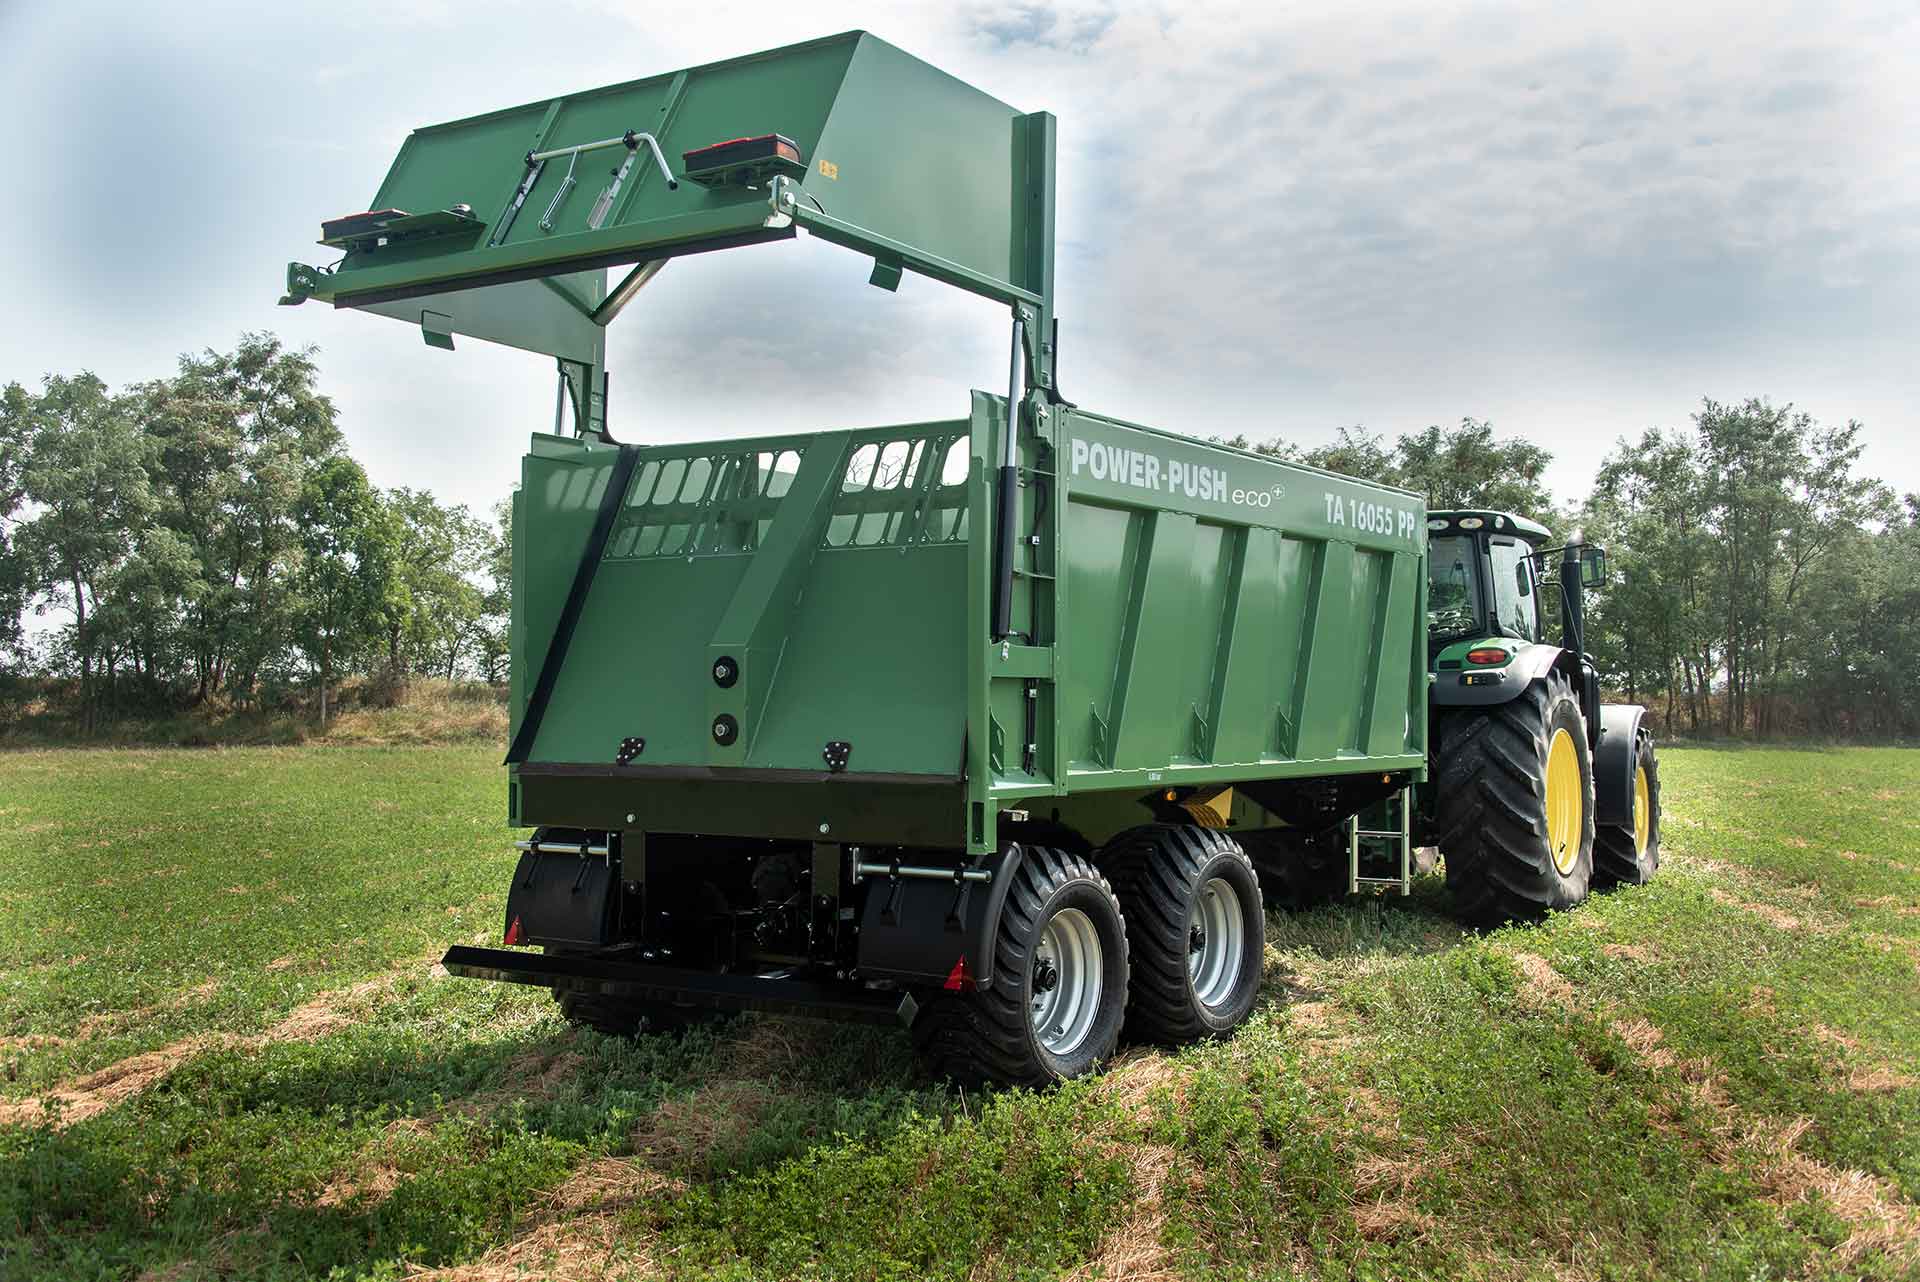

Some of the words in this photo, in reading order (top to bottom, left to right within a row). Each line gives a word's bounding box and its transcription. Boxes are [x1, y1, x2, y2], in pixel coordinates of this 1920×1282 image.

[1071, 438, 1228, 503] POWER-PUSH
[1324, 492, 1345, 526] TA
[1350, 499, 1393, 536] 16055
[1398, 510, 1415, 539] PP
